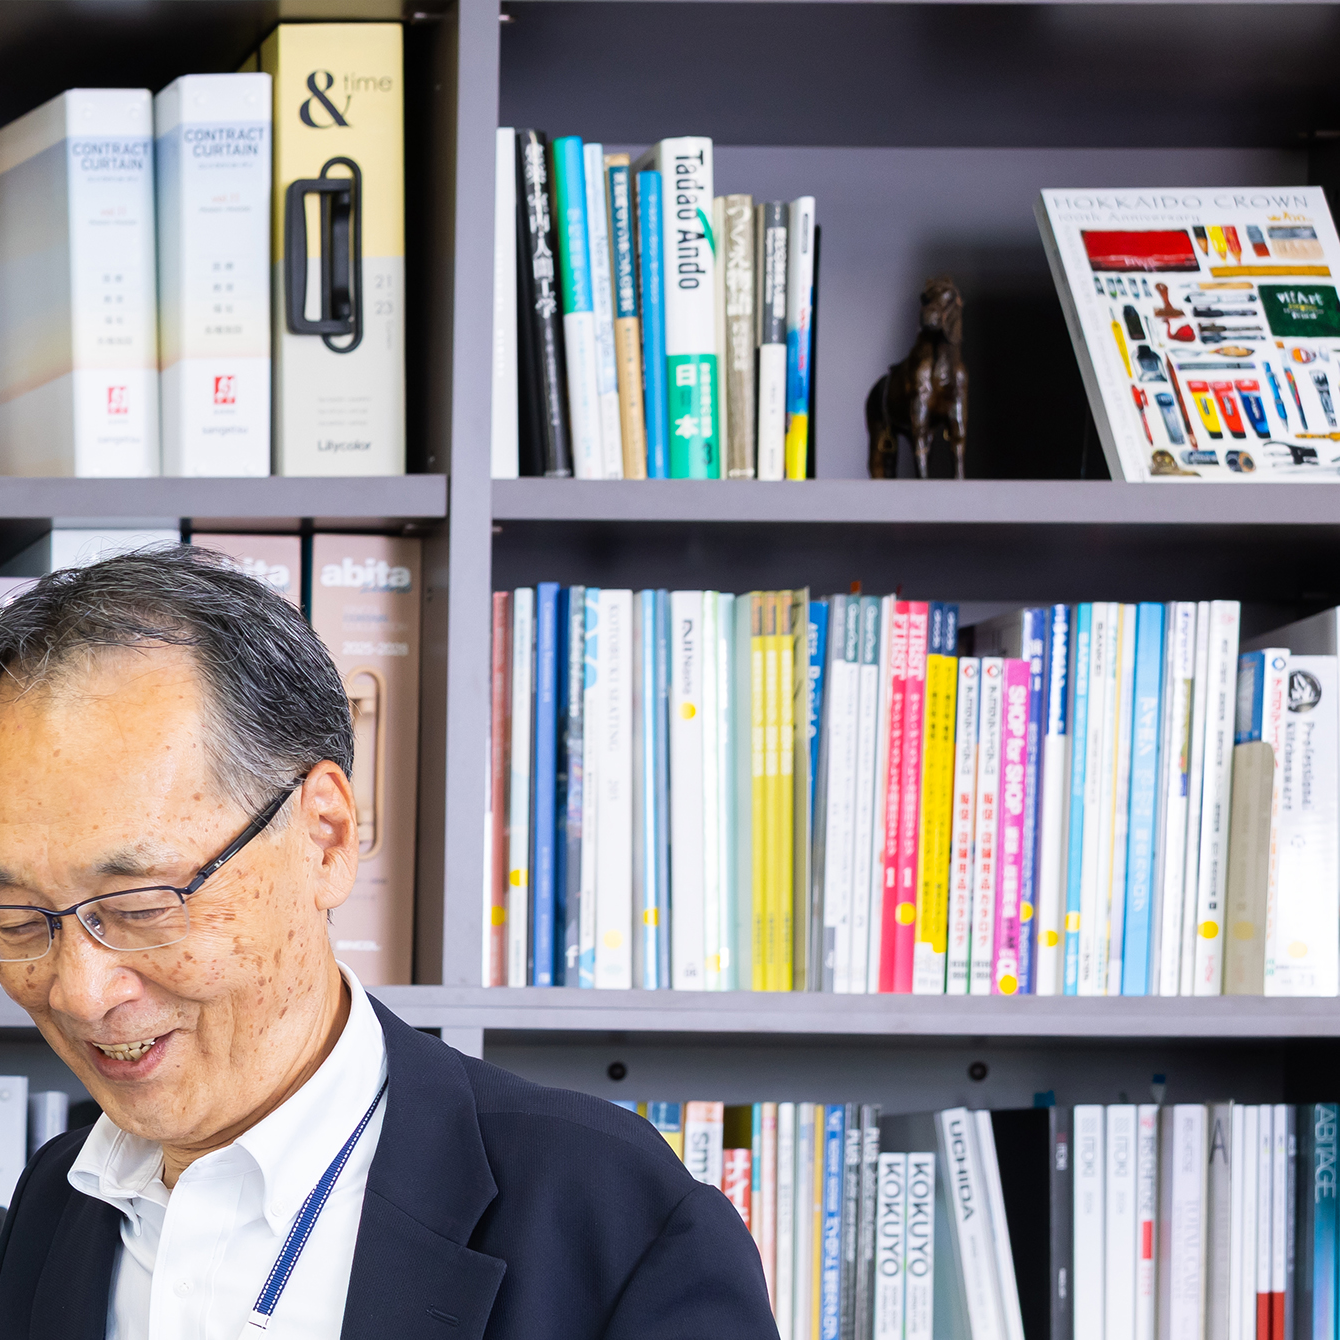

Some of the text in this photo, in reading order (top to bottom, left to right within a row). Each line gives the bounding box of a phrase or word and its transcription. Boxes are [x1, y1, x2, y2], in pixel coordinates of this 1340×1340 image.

[299, 69, 394, 129] & time
[72, 142, 150, 157] CONTRACT
[184, 128, 265, 144] CONTRACT
[192, 143, 259, 158] CURTAIN
[80, 157, 144, 171] CURTAIN
[675, 150, 707, 291] Tadao Ando
[1054, 194, 1309, 210] HOKKAIDO CROWN
[1108, 212, 1201, 224] Anniversary
[317, 440, 372, 454] Lilycolor
[320, 558, 412, 588] abita
[892, 612, 907, 682] FIRST
[908, 613, 924, 682] FIRST
[1005, 685, 1027, 815] SHOP for SHOP
[948, 1119, 976, 1222] UCHIDA
[882, 1161, 902, 1278] KOKUYO
[909, 1161, 929, 1278] KOKUYO
